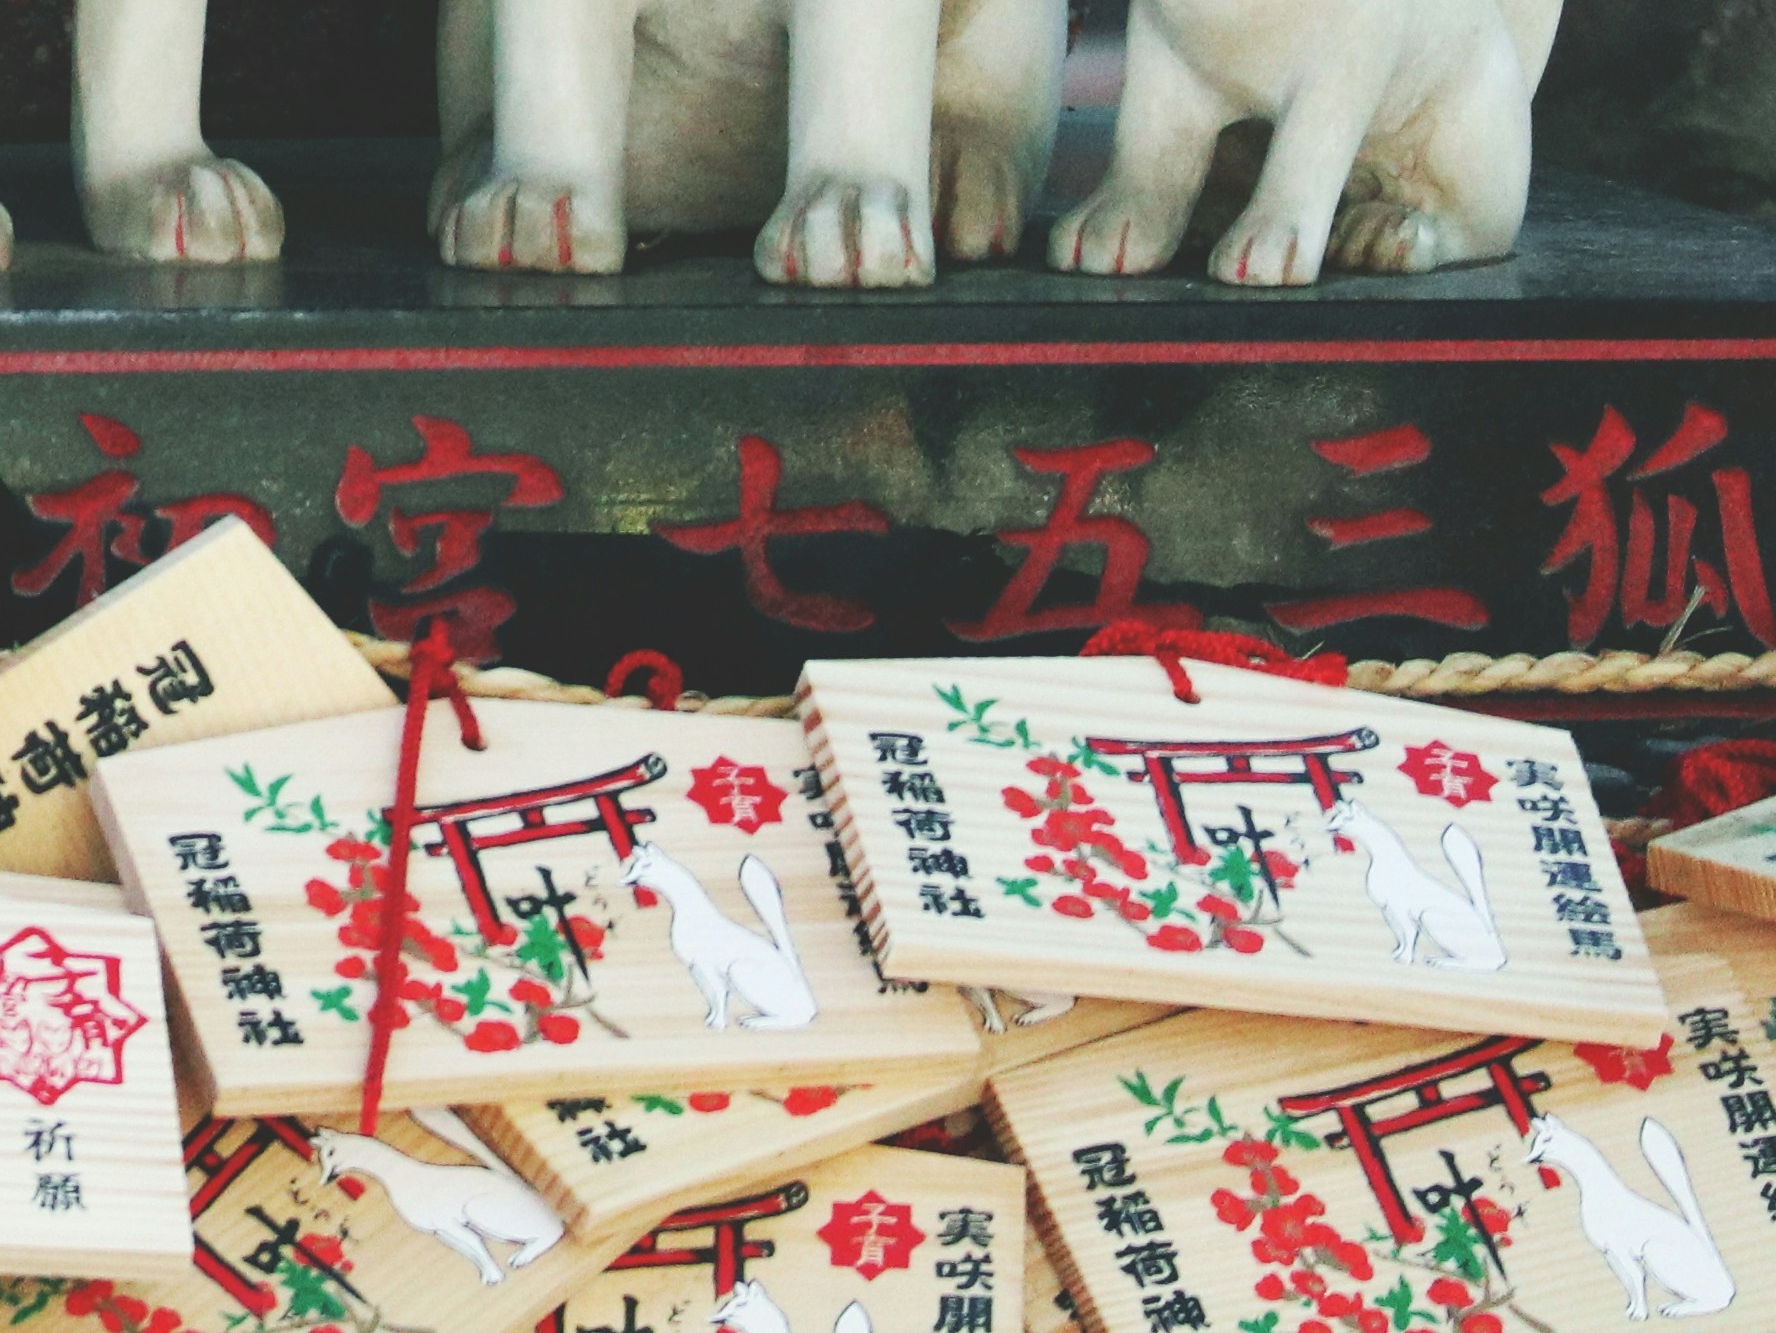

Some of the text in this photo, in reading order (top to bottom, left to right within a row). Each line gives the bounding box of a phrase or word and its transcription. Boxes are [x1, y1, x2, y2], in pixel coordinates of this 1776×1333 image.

[869, 732, 986, 919] 冠稲荷神社
[168, 833, 305, 1047] 冠稲荷神社
[1678, 1006, 1776, 1221] 実咲開運
